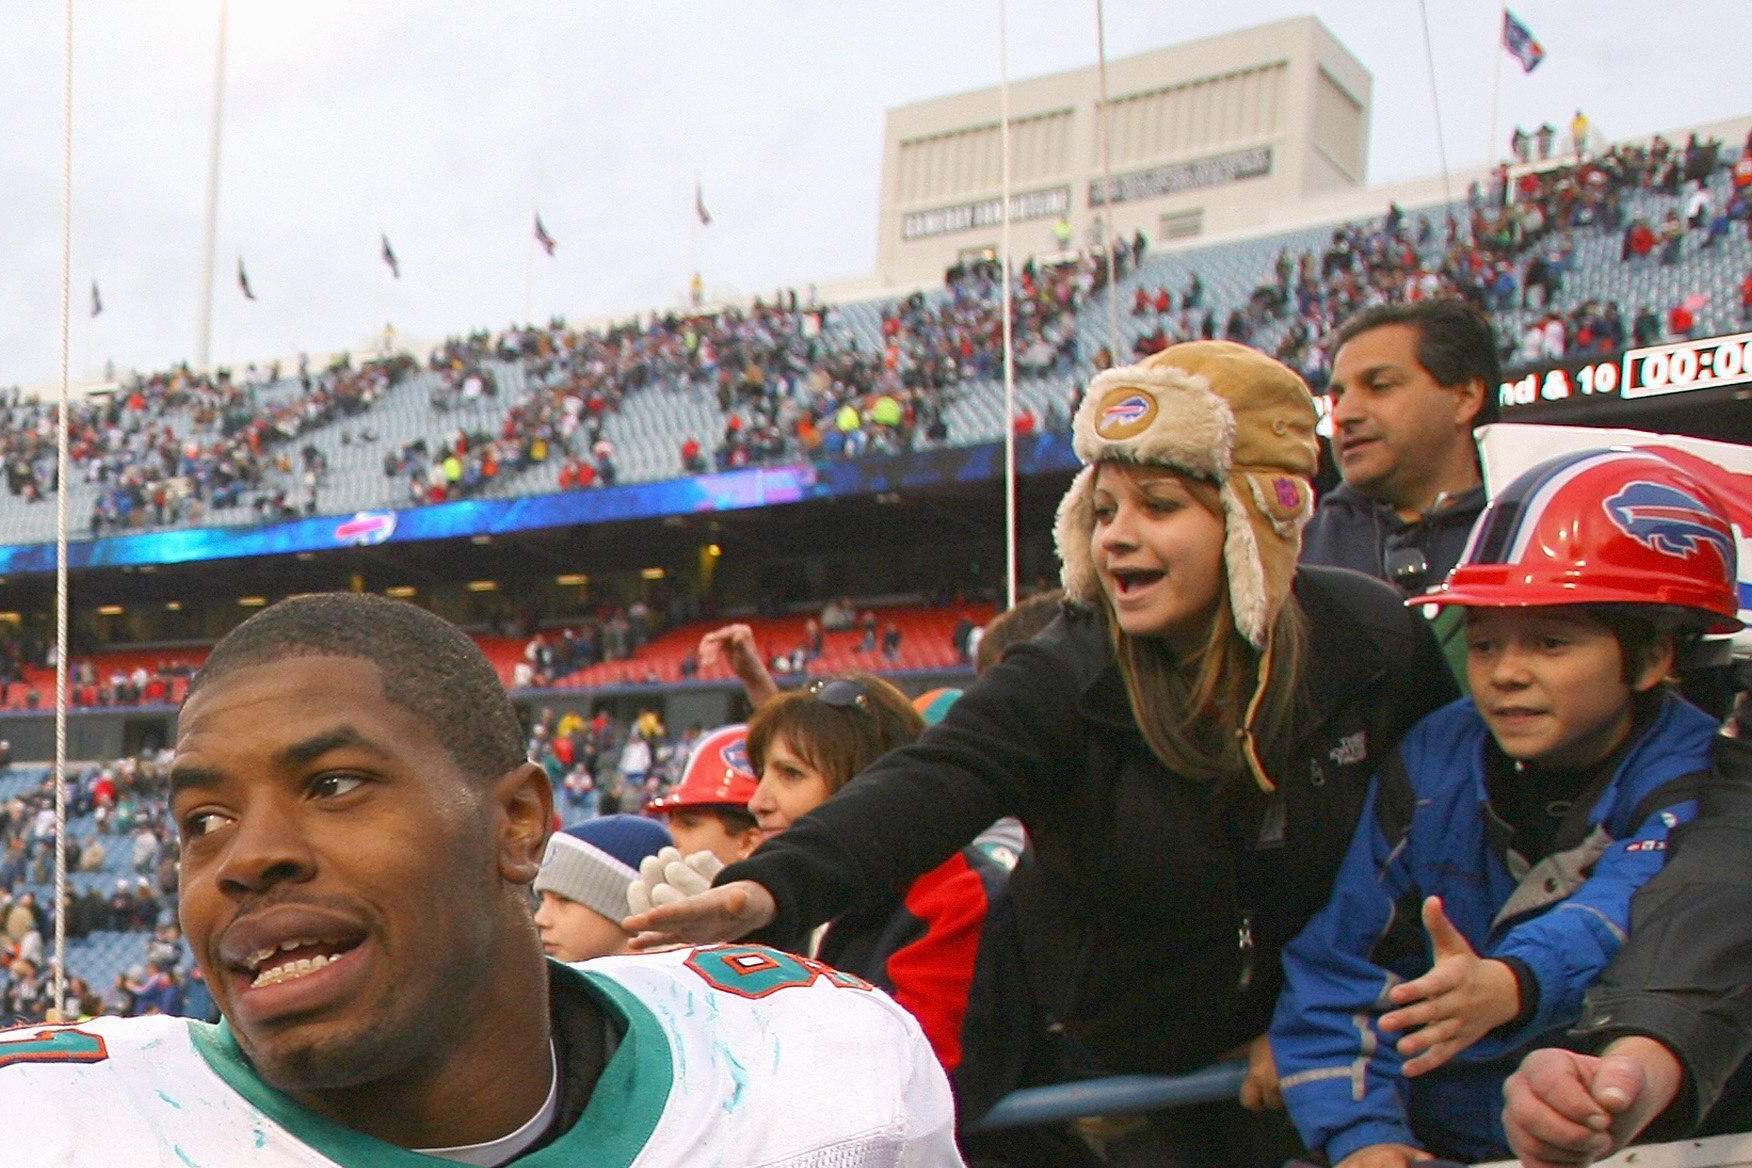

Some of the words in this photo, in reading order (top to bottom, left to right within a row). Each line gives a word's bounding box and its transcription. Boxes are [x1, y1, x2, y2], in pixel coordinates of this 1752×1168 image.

[1498, 372, 1541, 406] nd
[1541, 369, 1573, 400] &
[1575, 361, 1620, 395] 10
[1641, 341, 1752, 389] 00:0
